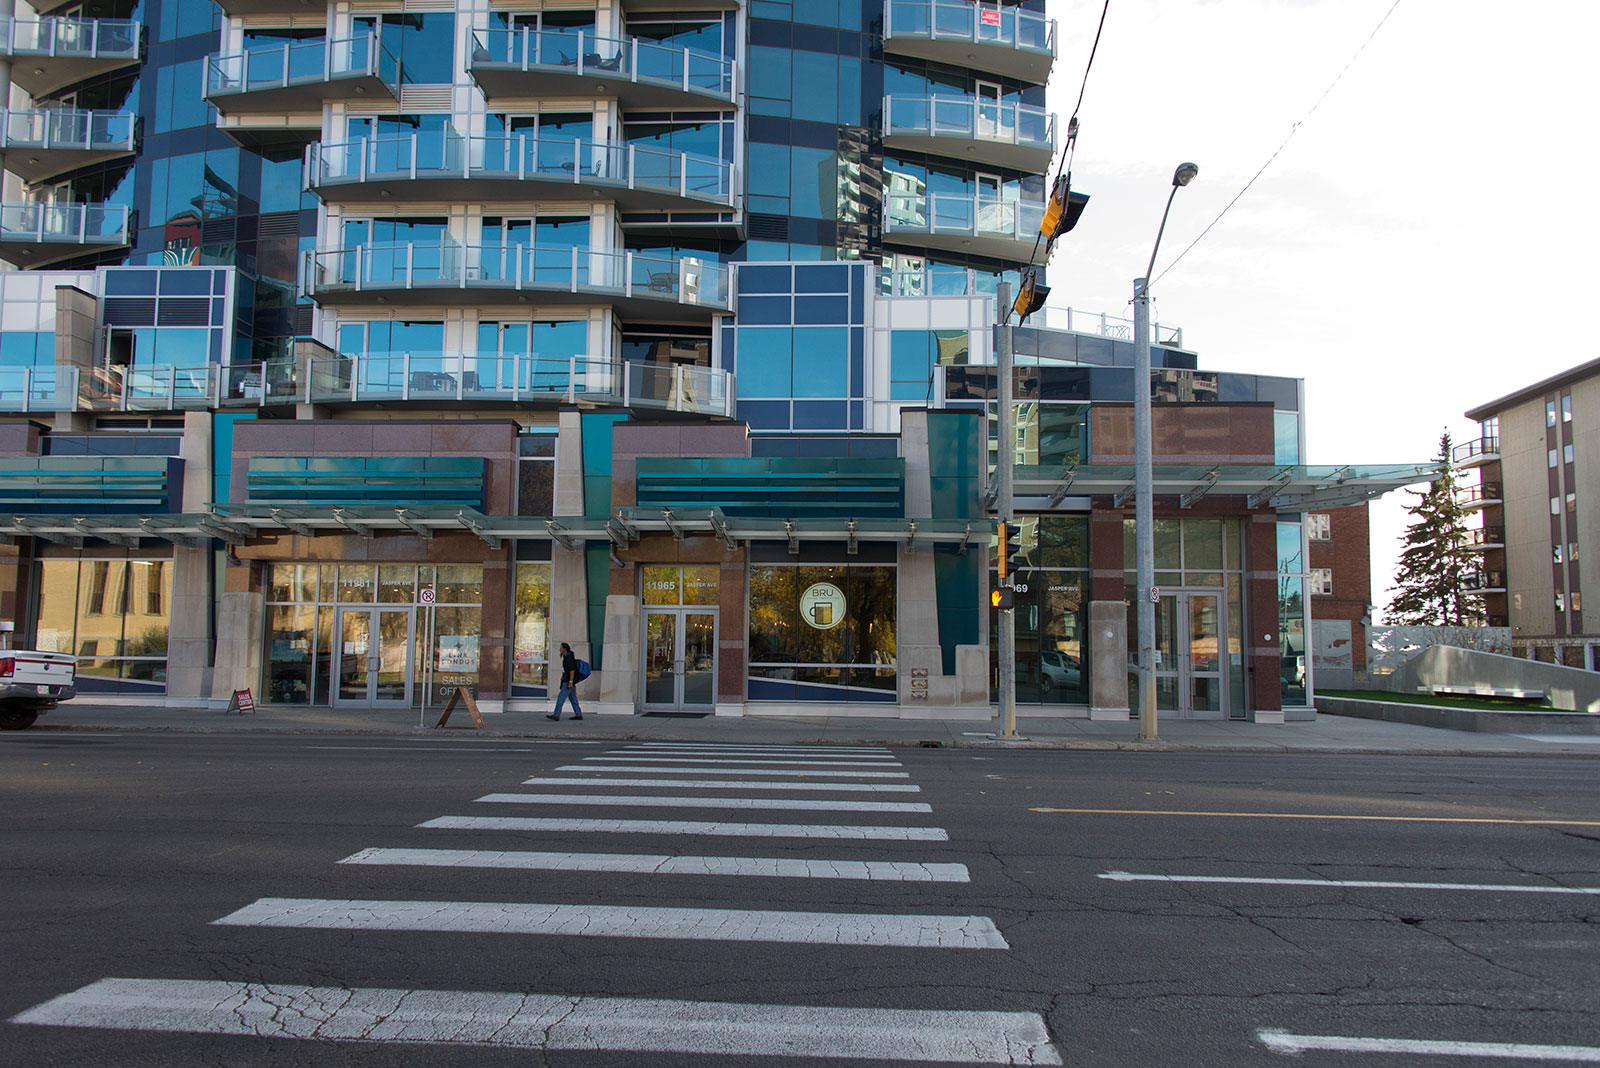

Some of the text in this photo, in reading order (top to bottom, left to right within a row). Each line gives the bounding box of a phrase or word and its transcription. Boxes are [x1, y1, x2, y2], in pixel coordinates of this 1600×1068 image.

[646, 581, 675, 590] 11965
[812, 589, 834, 597] BRU
[441, 675, 473, 685] SALES
